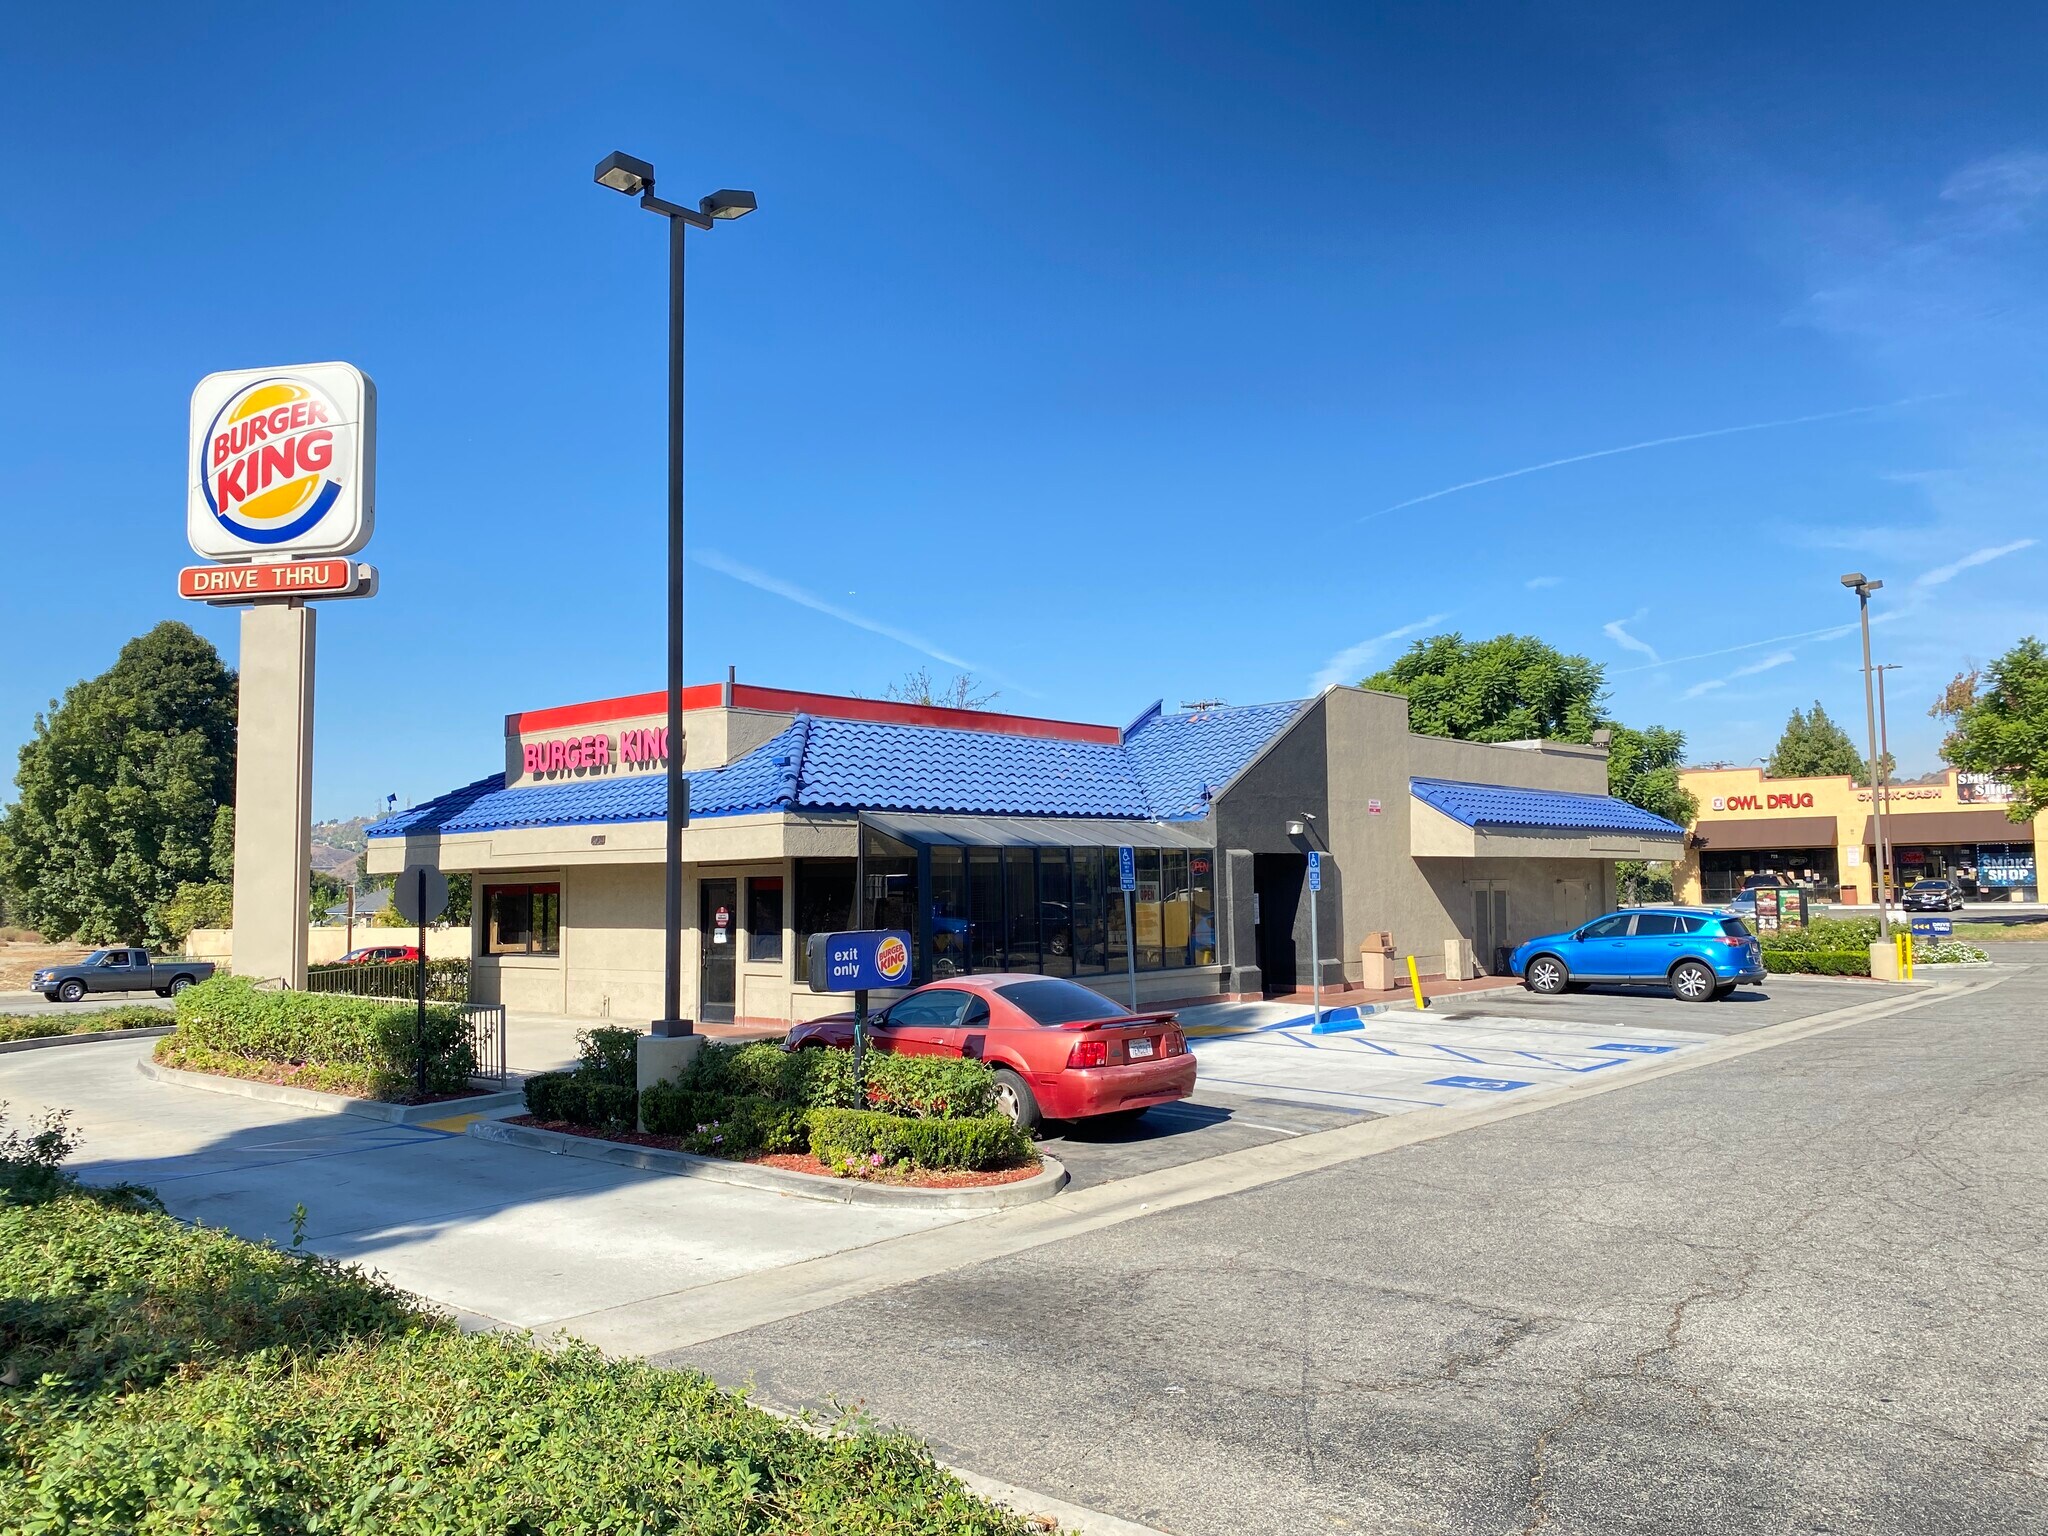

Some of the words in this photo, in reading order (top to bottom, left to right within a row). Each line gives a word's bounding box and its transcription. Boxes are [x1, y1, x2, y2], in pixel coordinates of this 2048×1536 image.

[214, 401, 328, 468] BURGER
[217, 429, 334, 515] KING
[194, 569, 258, 591] DRIVE
[272, 565, 329, 586] THRU
[524, 734, 610, 773] BURGER
[1726, 795, 1763, 811] OWL
[1767, 793, 1814, 810] DRUG
[1190, 860, 1209, 873] OPEN
[1983, 857, 2034, 869] SMOKE
[1988, 868, 2029, 881] SHOP
[1140, 889, 1155, 901] OPEN
[834, 948, 858, 962] exit
[878, 944, 904, 962] BURGER
[879, 951, 905, 972] KING
[833, 963, 860, 978] only
